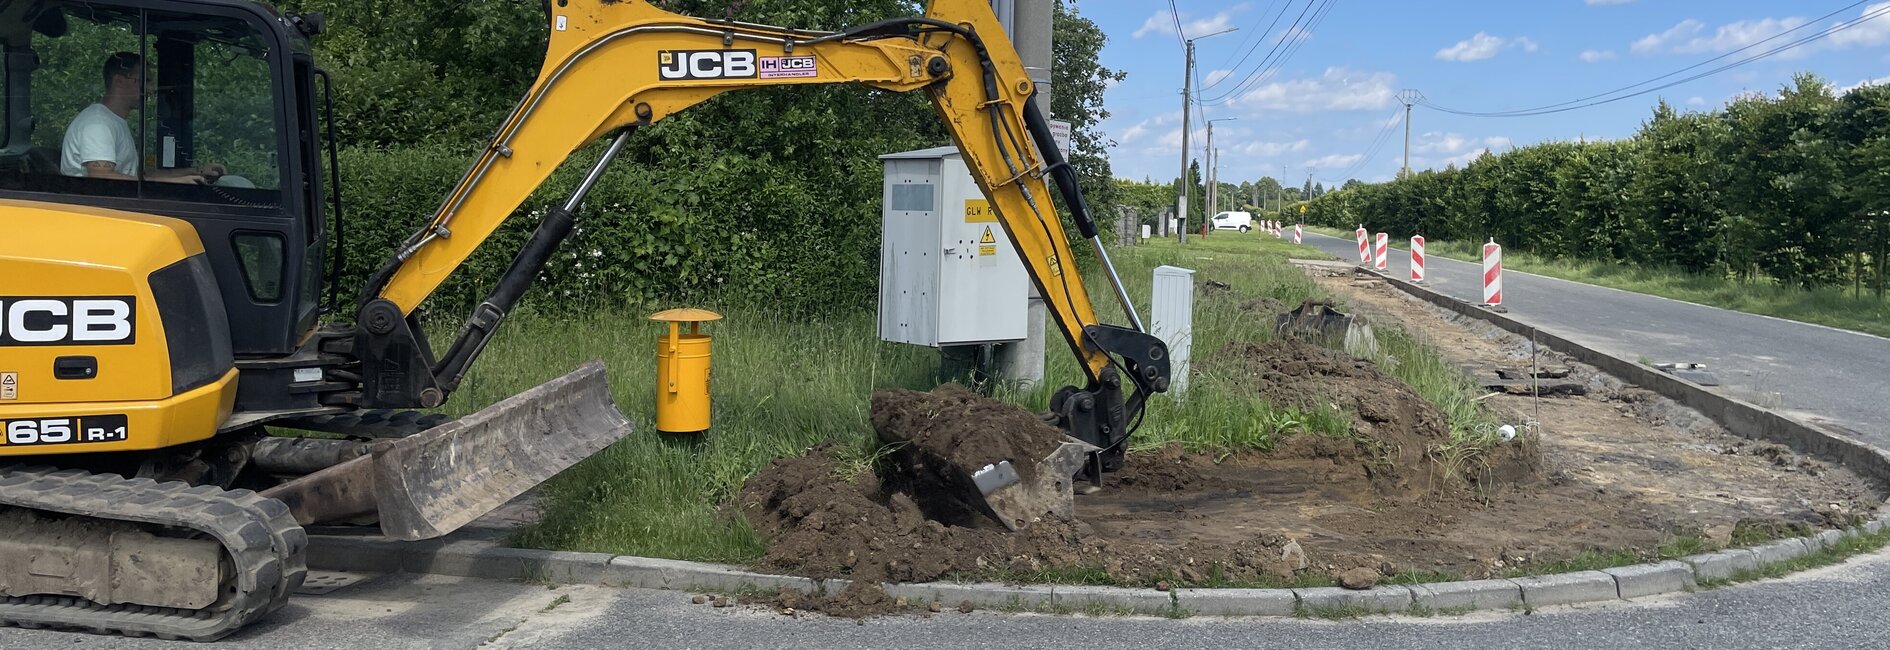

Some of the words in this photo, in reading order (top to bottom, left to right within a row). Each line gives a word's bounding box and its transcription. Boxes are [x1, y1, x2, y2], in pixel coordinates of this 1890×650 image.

[661, 51, 756, 79] JCB
[762, 60, 777, 69] IH
[781, 58, 815, 69] JCB
[966, 206, 981, 216] GLW
[0, 299, 131, 342] CB
[7, 418, 72, 444] 65
[87, 426, 126, 442] R-1
